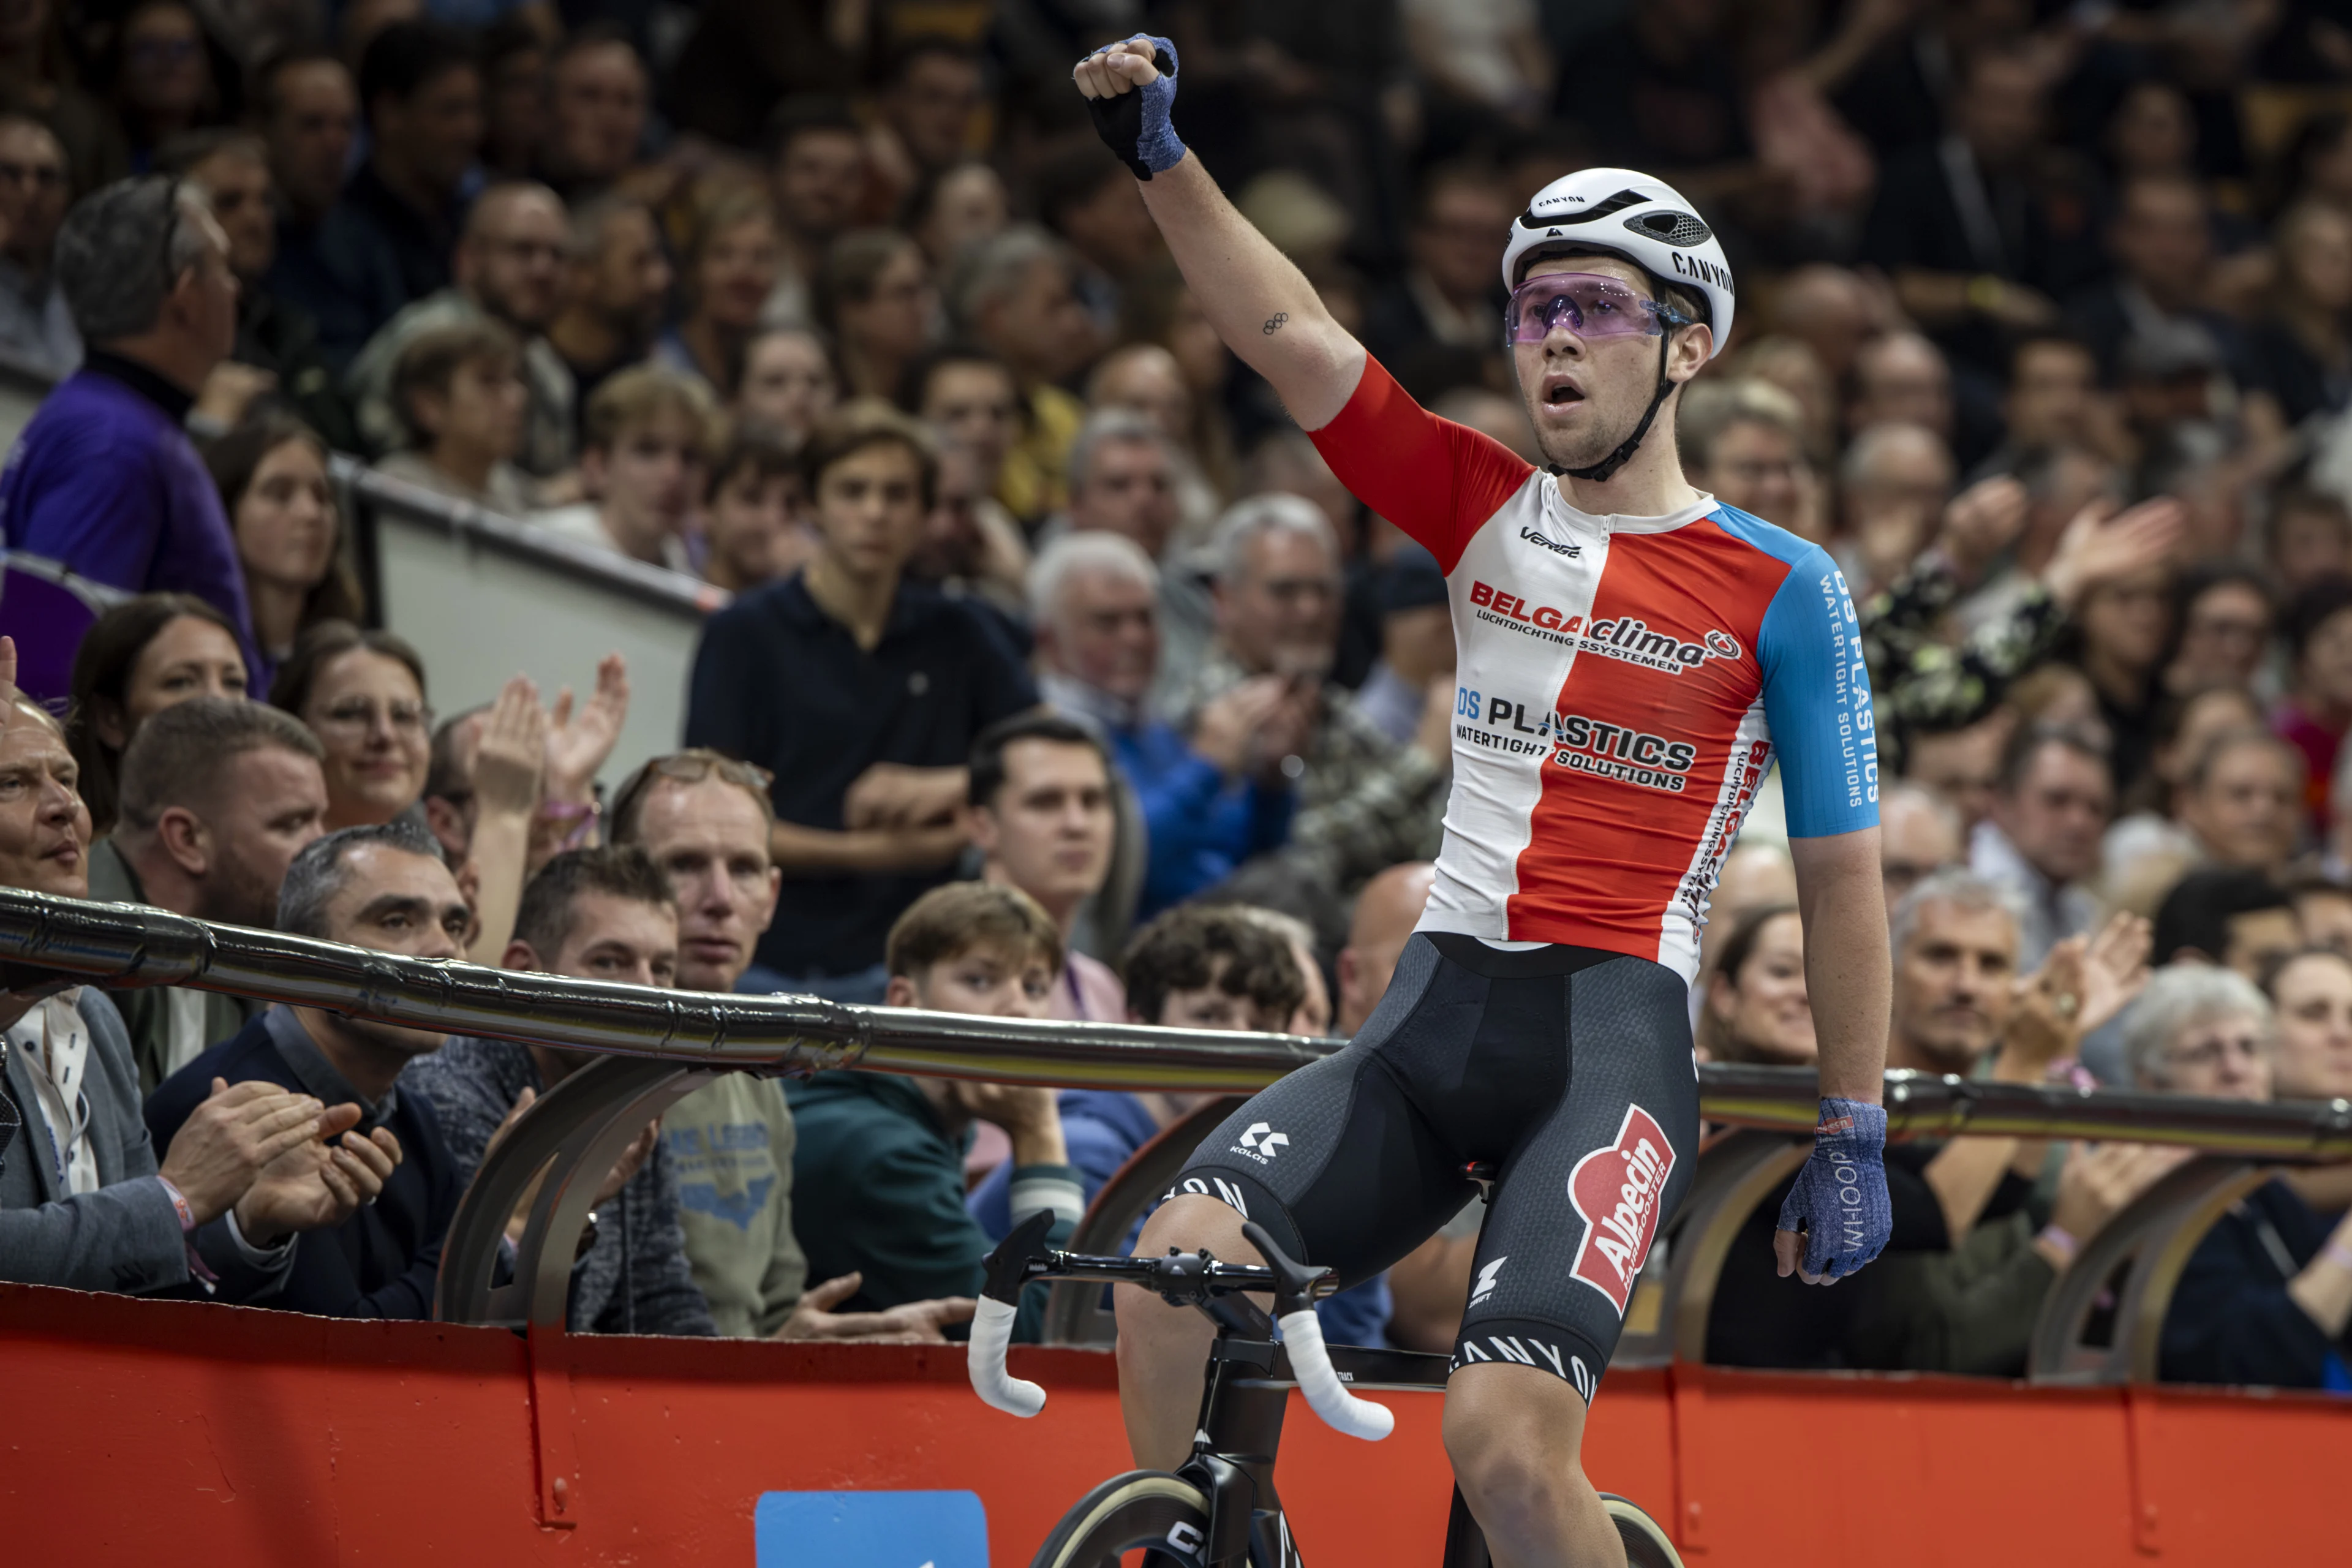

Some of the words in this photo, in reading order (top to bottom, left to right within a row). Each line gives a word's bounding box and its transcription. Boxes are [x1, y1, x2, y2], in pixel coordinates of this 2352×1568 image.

[1539, 196, 1585, 207] CANYON
[1672, 251, 1735, 297] CANYON
[1520, 526, 1583, 559] VERGE
[1458, 687, 1481, 720] DS
[1488, 697, 1694, 772] PLASTICS
[1820, 574, 1847, 705] WATERTIGHT
[1838, 712, 1863, 808] SOLUTIONS
[1834, 570, 1858, 624] DS
[1850, 635, 1879, 804] PLASTICS
[1456, 723, 1547, 756] WATERTIGHT
[1556, 751, 1683, 791] SOLUTIONS
[1594, 1137, 1661, 1282] Alpecin
[1624, 1246, 1639, 1291] HAIR
[1637, 1161, 1667, 1241] BOOSTER
[1828, 1152, 1864, 1253] WHOOP
[1468, 1292, 1493, 1310] ZWIFT
